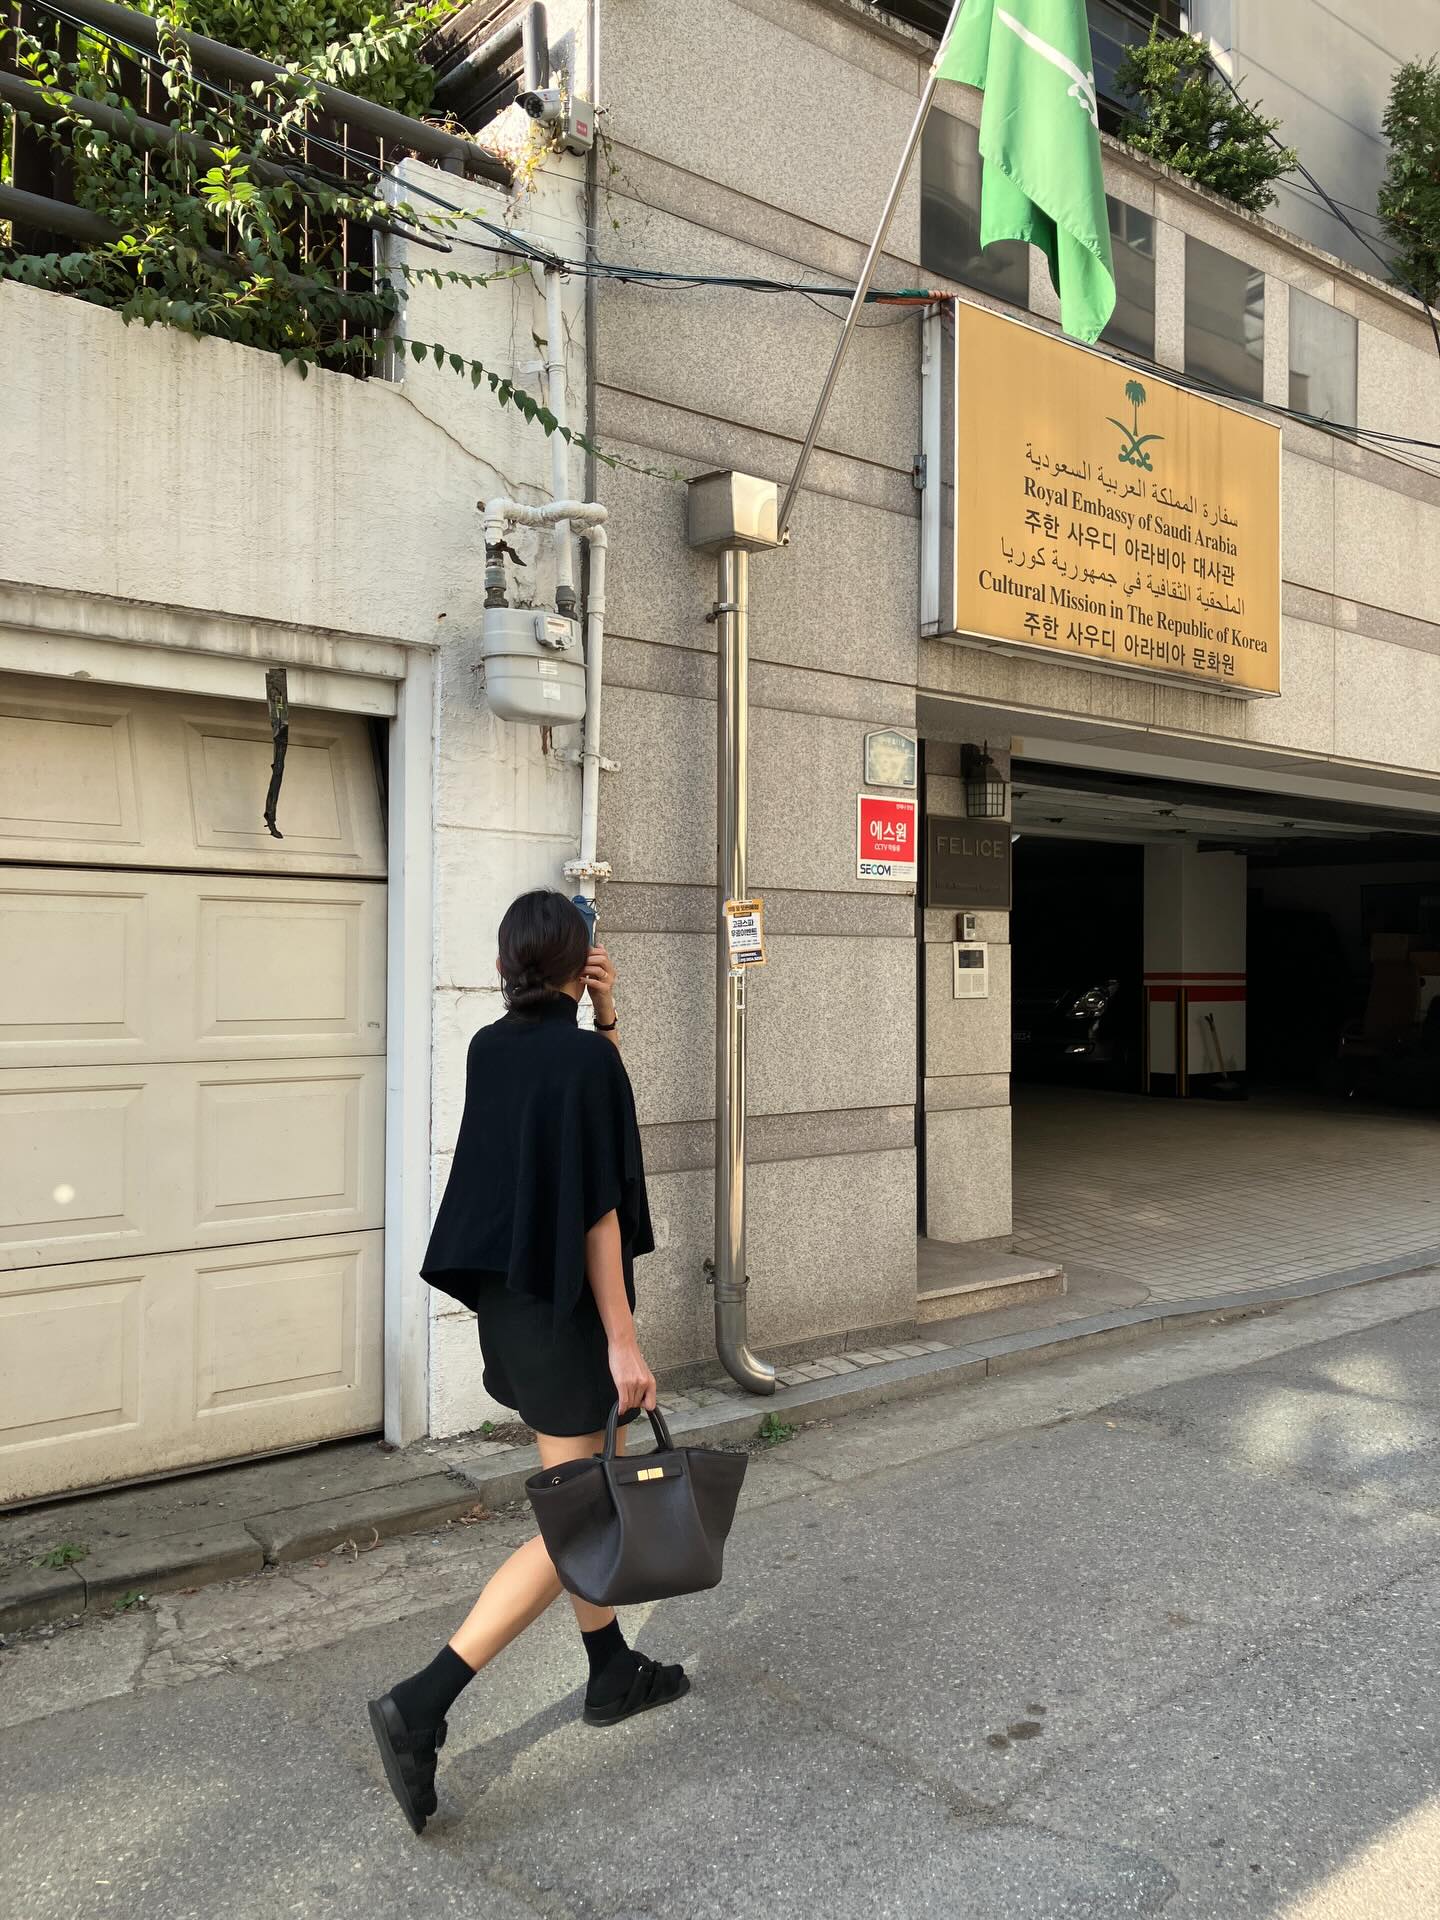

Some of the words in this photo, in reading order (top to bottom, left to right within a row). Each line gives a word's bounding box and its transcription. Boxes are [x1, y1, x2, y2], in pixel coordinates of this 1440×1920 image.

[1025, 442, 1091, 481] السعودية
[1097, 466, 1146, 499] العربية
[1151, 483, 1197, 514] المملكة
[1023, 475, 1068, 507] Royal
[1071, 490, 1135, 530] Embassy
[1138, 513, 1153, 531] of
[1154, 515, 1192, 543] Saudi
[1194, 528, 1238, 557] Arabia
[1202, 503, 1239, 528] سفارة
[1001, 536, 1046, 570] كوريا
[1024, 508, 1060, 540] 주한
[1067, 522, 1116, 556] 사우디
[1125, 538, 1186, 574] 아라비아
[1193, 557, 1235, 587] 대사관
[1051, 549, 1118, 588] جمهورية
[1123, 571, 1142, 598] في
[1146, 573, 1191, 601] الثقافية
[1196, 586, 1245, 617] الملحقية
[978, 569, 1046, 603] Cultural
[1049, 585, 1107, 617] Mission
[1109, 599, 1124, 621] in
[1127, 603, 1154, 627] The
[1156, 610, 1214, 641] Republic
[1216, 626, 1230, 644] of
[1231, 628, 1268, 654] Korea
[1023, 611, 1059, 641] 주한
[1066, 621, 1116, 653] 사우디
[1124, 634, 1186, 666] 아라비아
[1192, 647, 1235, 677] 문화원
[870, 820, 907, 842] 에스원
[936, 836, 1004, 859] FELICE
[860, 863, 891, 876] SECOM
